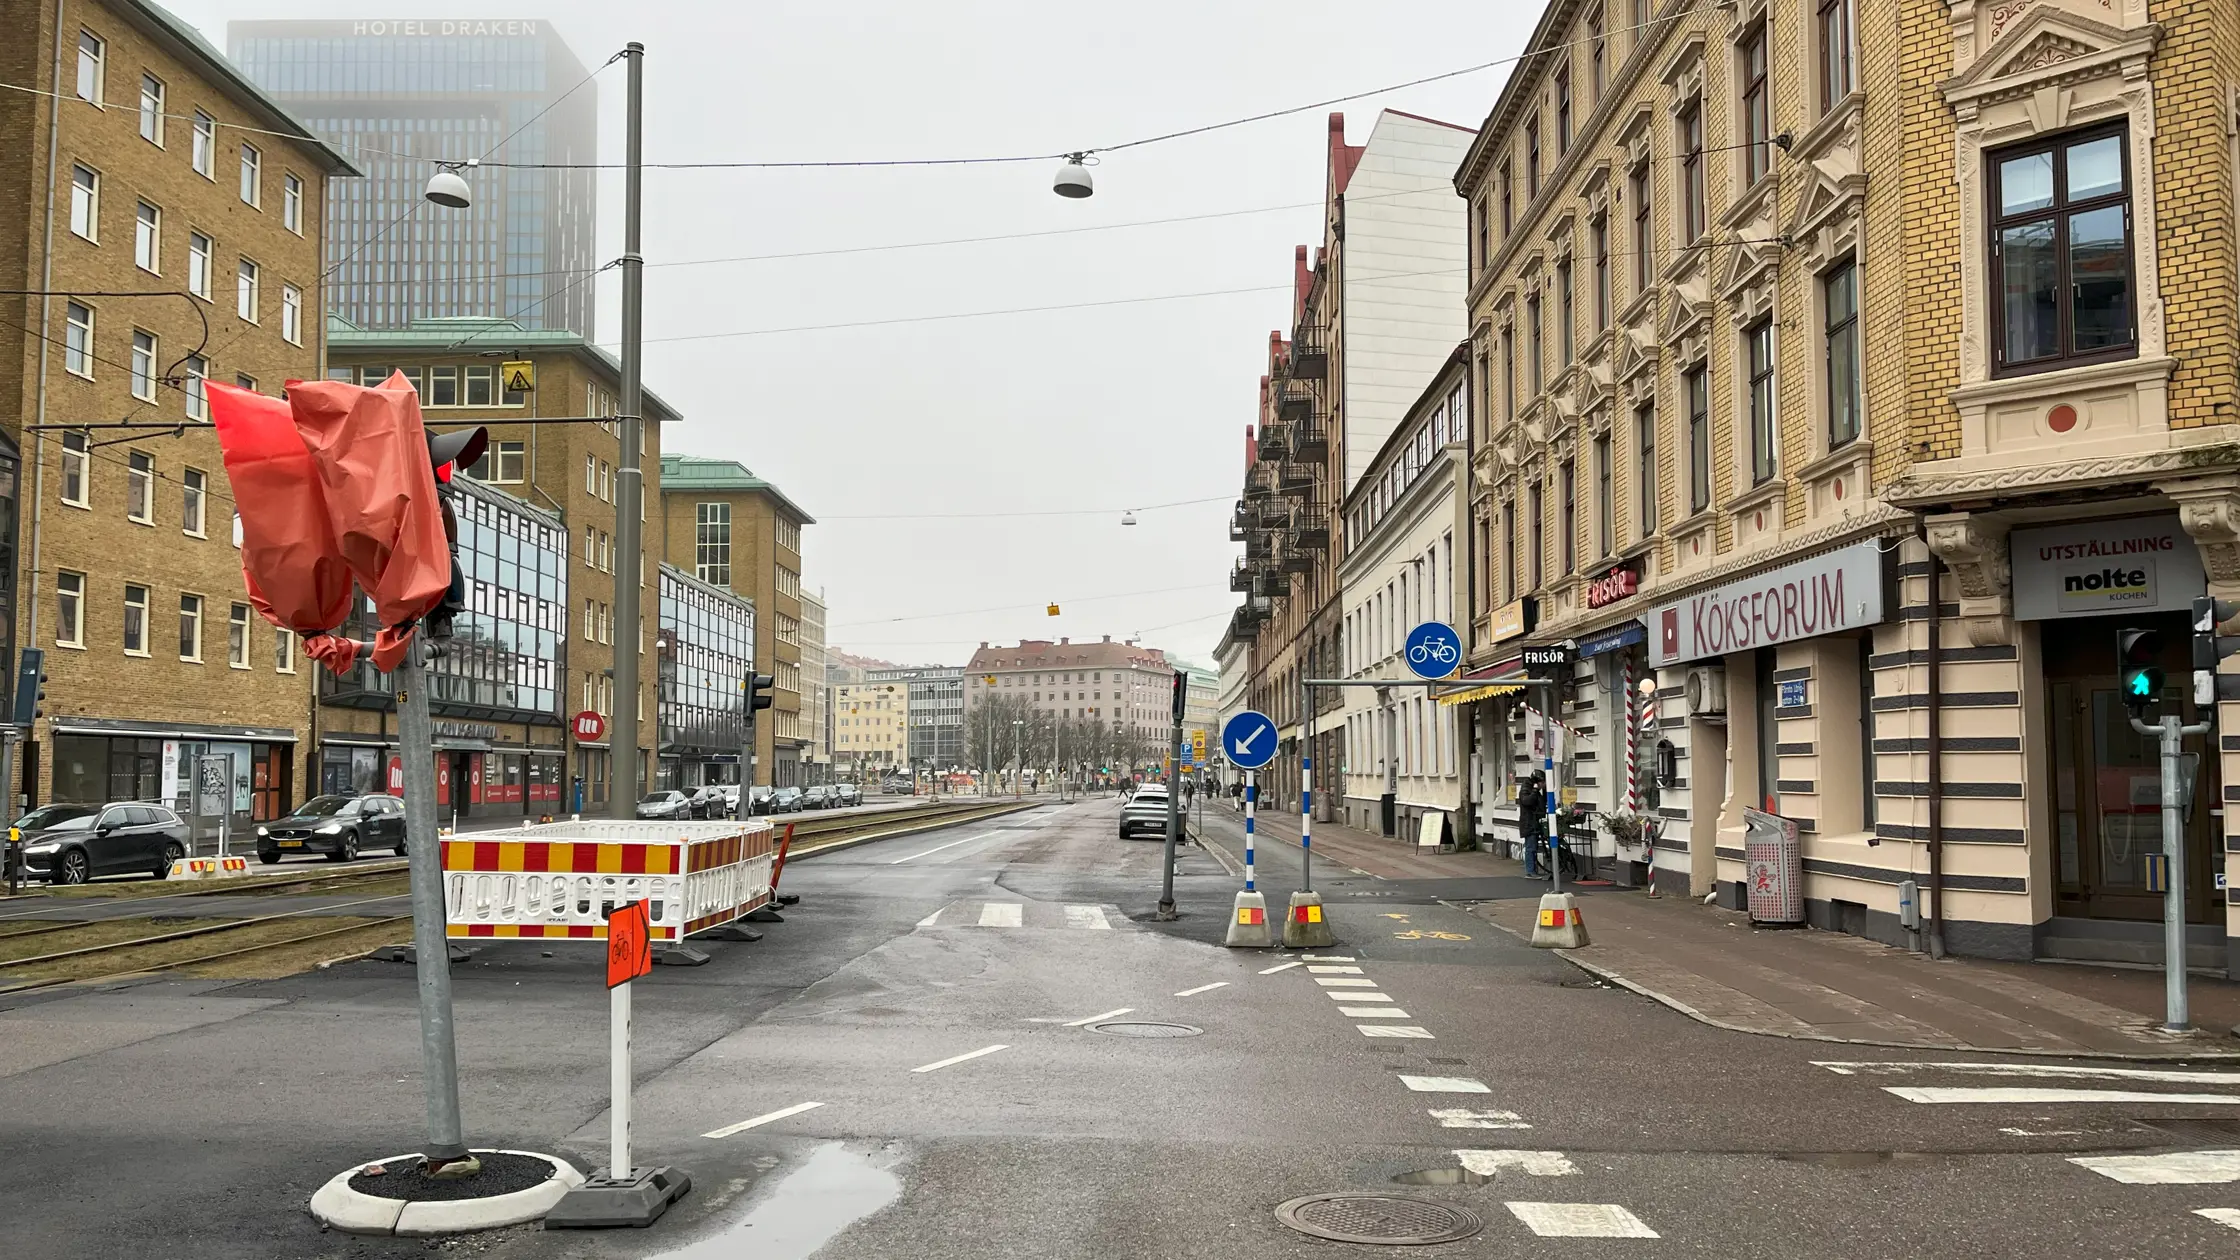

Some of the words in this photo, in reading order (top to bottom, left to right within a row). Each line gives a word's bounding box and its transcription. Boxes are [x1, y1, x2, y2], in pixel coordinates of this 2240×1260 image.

[353, 21, 430, 36] HOTEL
[441, 21, 536, 36] DRAKEN
[2039, 536, 2173, 561] UTSTÄLLNING
[1585, 567, 1627, 608] FRISÖR
[2064, 567, 2146, 592] nolte
[2109, 591, 2147, 602] KÜCHEN
[1692, 568, 1846, 656] KÖKSFORUM
[1525, 649, 1564, 664] FRISÖR
[397, 690, 408, 703] 25
